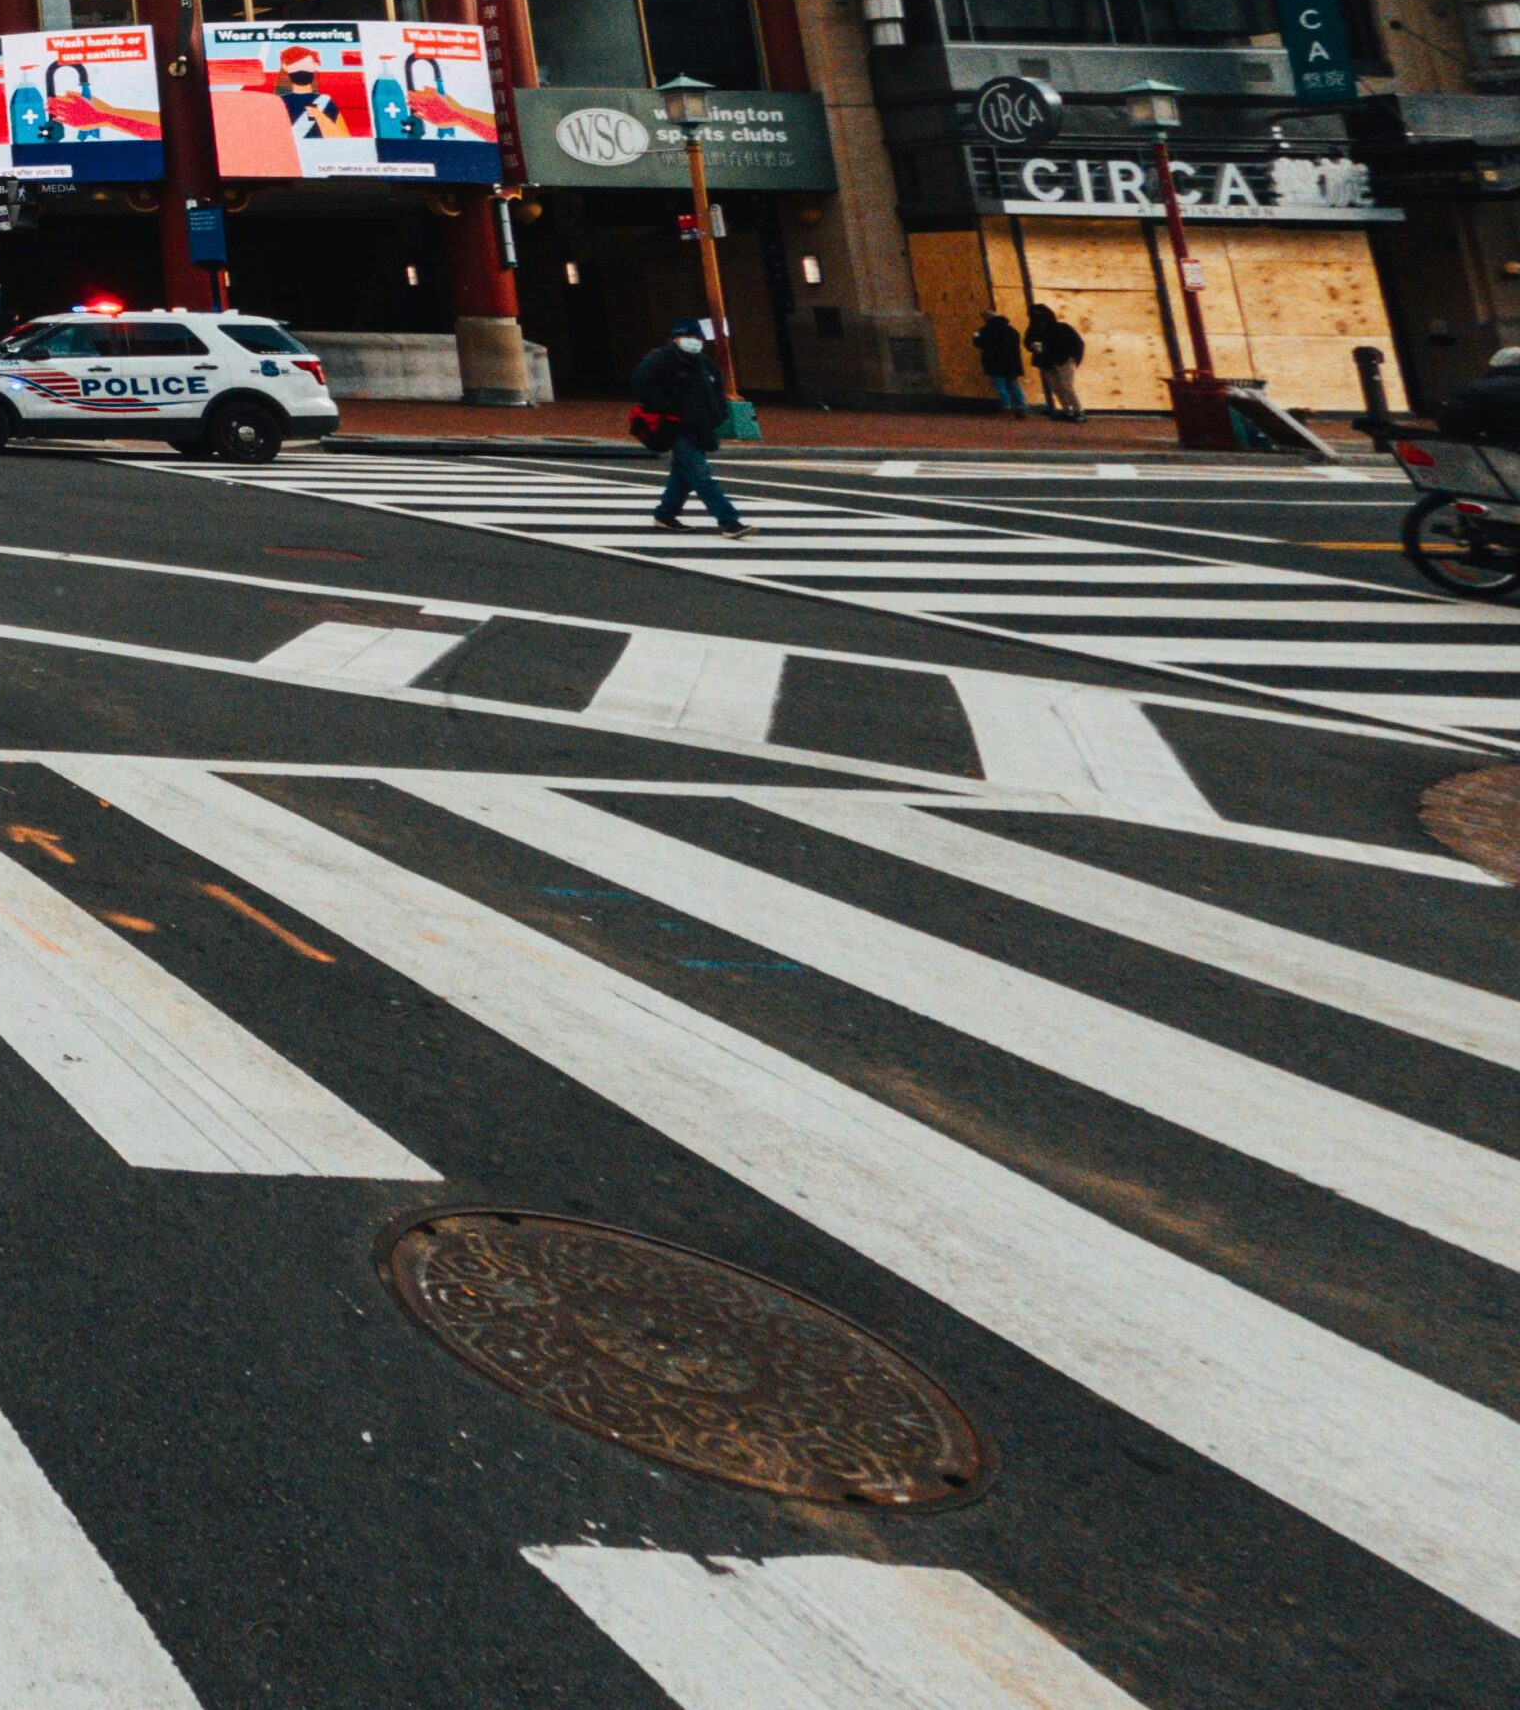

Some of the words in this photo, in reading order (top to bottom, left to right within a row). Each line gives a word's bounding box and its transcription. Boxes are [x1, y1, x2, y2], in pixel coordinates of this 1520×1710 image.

[51, 38, 84, 48] Wash
[87, 36, 125, 46] hands
[126, 36, 141, 45] or
[218, 30, 254, 41] Wear
[256, 32, 265, 41] a
[267, 29, 296, 41] face
[300, 30, 353, 42] covering
[62, 52, 84, 61] use
[86, 48, 143, 60] sanitizer.
[566, 113, 637, 160] WSC
[730, 127, 788, 143] clubs
[1022, 158, 1258, 206] CIRCA
[41, 184, 76, 194] MEDIA
[1178, 207, 1276, 218] HINATOWN
[79, 375, 210, 397] POLICE
